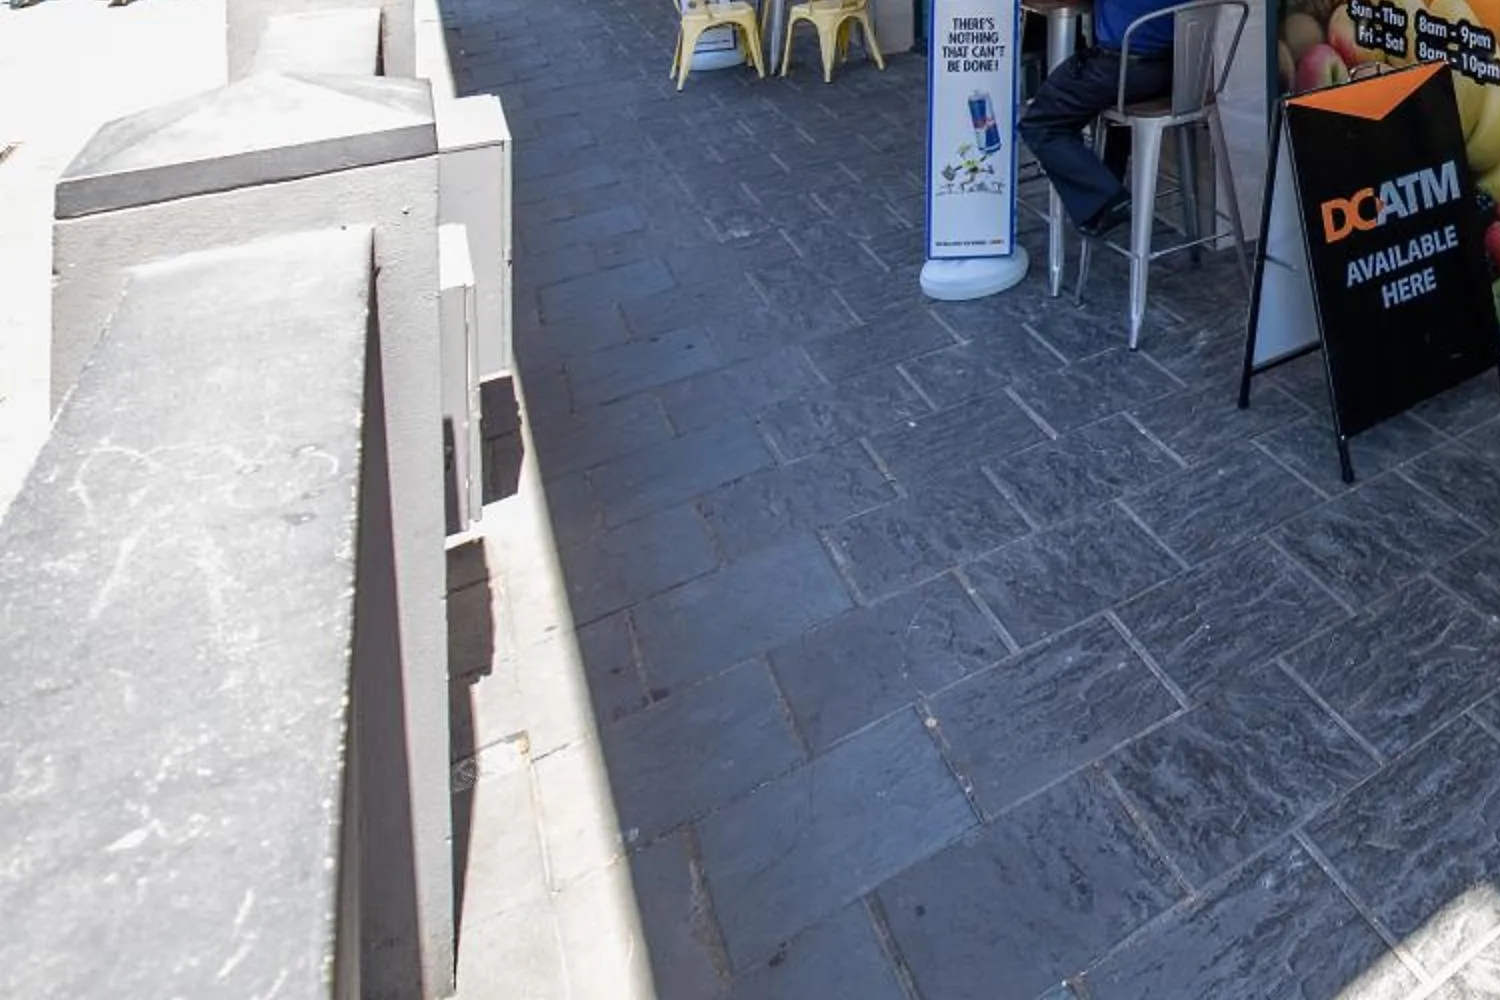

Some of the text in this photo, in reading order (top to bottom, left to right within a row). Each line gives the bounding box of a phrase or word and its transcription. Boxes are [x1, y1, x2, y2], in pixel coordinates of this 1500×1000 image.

[948, 31, 1000, 46] NOTHING
[952, 17, 995, 31] THERE'S
[1351, 0, 1373, 19] Sun
[1383, 7, 1405, 27] Thu
[1418, 15, 1447, 38] 8am
[1460, 25, 1491, 51] 9pm
[942, 44, 1006, 60] THAT CAN'T
[947, 58, 1000, 73] BE DONE!
[1358, 25, 1374, 44] Fri
[1384, 33, 1404, 53] Sat
[1418, 41, 1447, 62] 8am
[1461, 55, 1500, 81] 10pm
[1346, 225, 1459, 288] AVAILABLE
[1381, 268, 1438, 310] HERE
